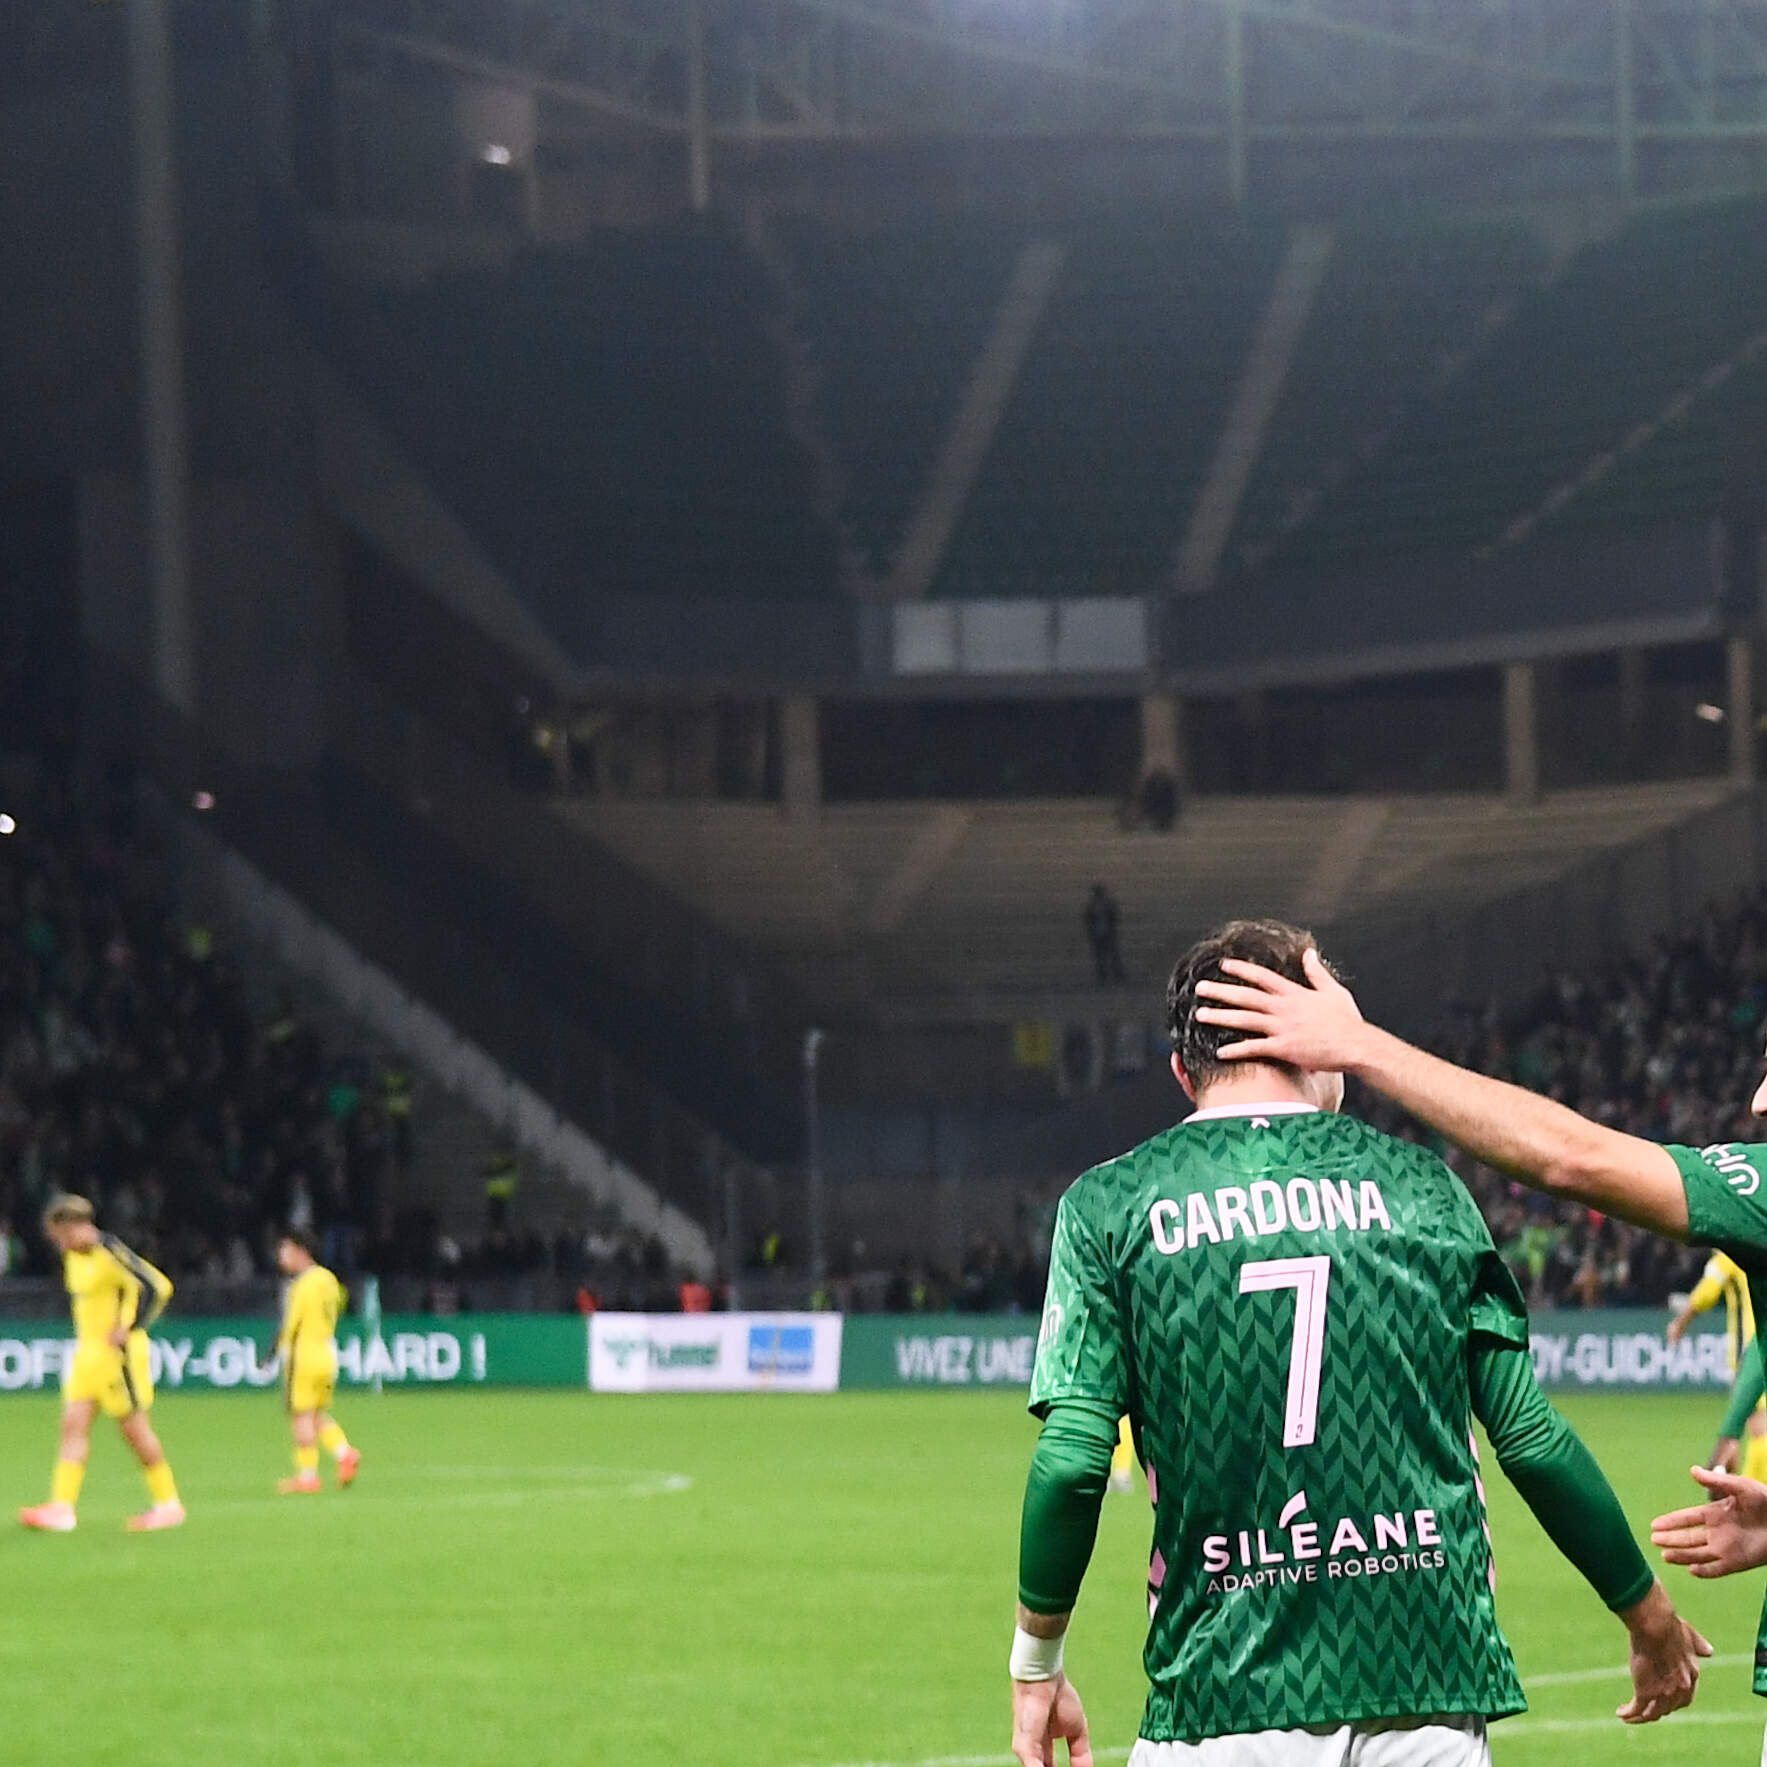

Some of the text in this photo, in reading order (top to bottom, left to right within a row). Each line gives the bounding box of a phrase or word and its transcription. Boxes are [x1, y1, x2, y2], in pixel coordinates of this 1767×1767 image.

[1149, 1177, 1392, 1255] CARDONA
[1238, 1255, 1332, 1448] 7
[1206, 1549, 1446, 1596] ADAPTIVE ROBOTICS
